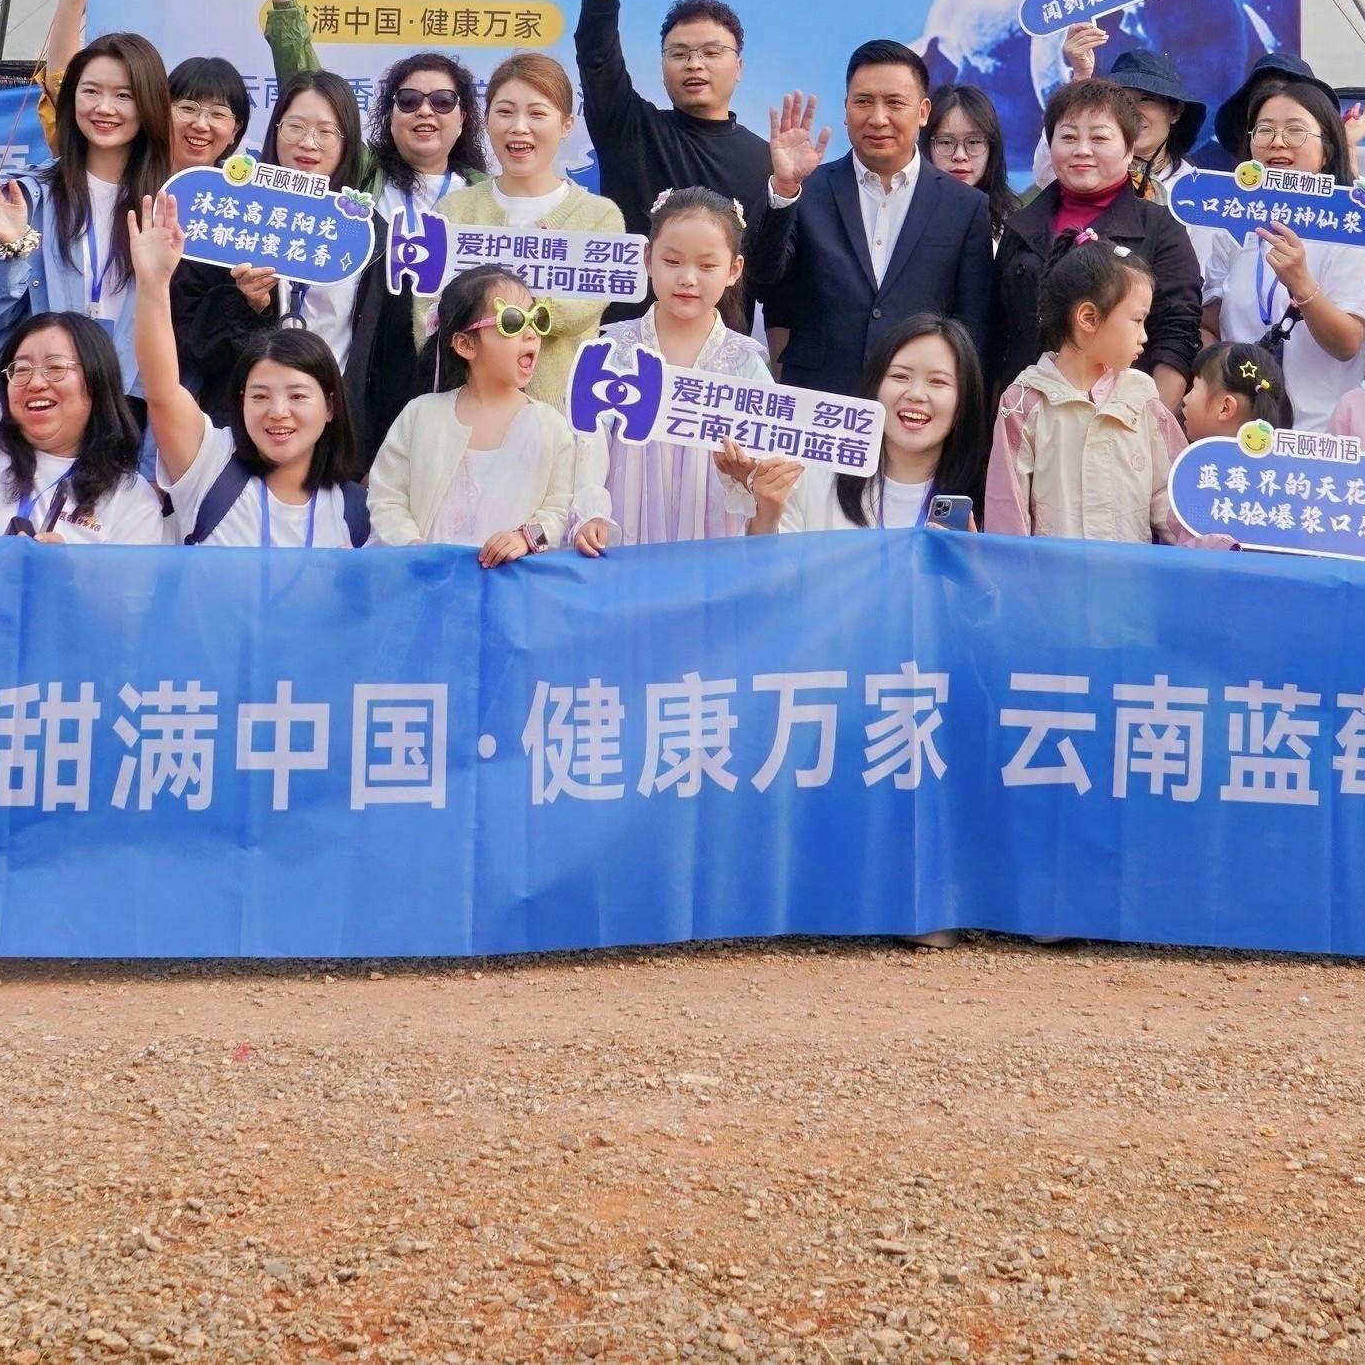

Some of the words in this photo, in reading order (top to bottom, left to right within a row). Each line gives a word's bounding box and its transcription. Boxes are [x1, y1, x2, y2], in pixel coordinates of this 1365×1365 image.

[303, 2, 543, 40] 满中国·健康万家
[254, 164, 328, 197] 辰颐物语
[1264, 169, 1334, 196] 辰颐物语
[190, 191, 338, 241] 沐浴高原阳光
[185, 218, 332, 268] 浓郁甜蜜花香
[455, 232, 569, 262] 爱护眼睛
[583, 239, 641, 266] 多吃
[453, 259, 639, 296] 红河蓝莓
[670, 374, 797, 423] 爱护眼睛
[812, 400, 877, 436] 多吃
[665, 407, 871, 469] 云南红河蓝莓
[1275, 431, 1359, 462] 辰颐物语
